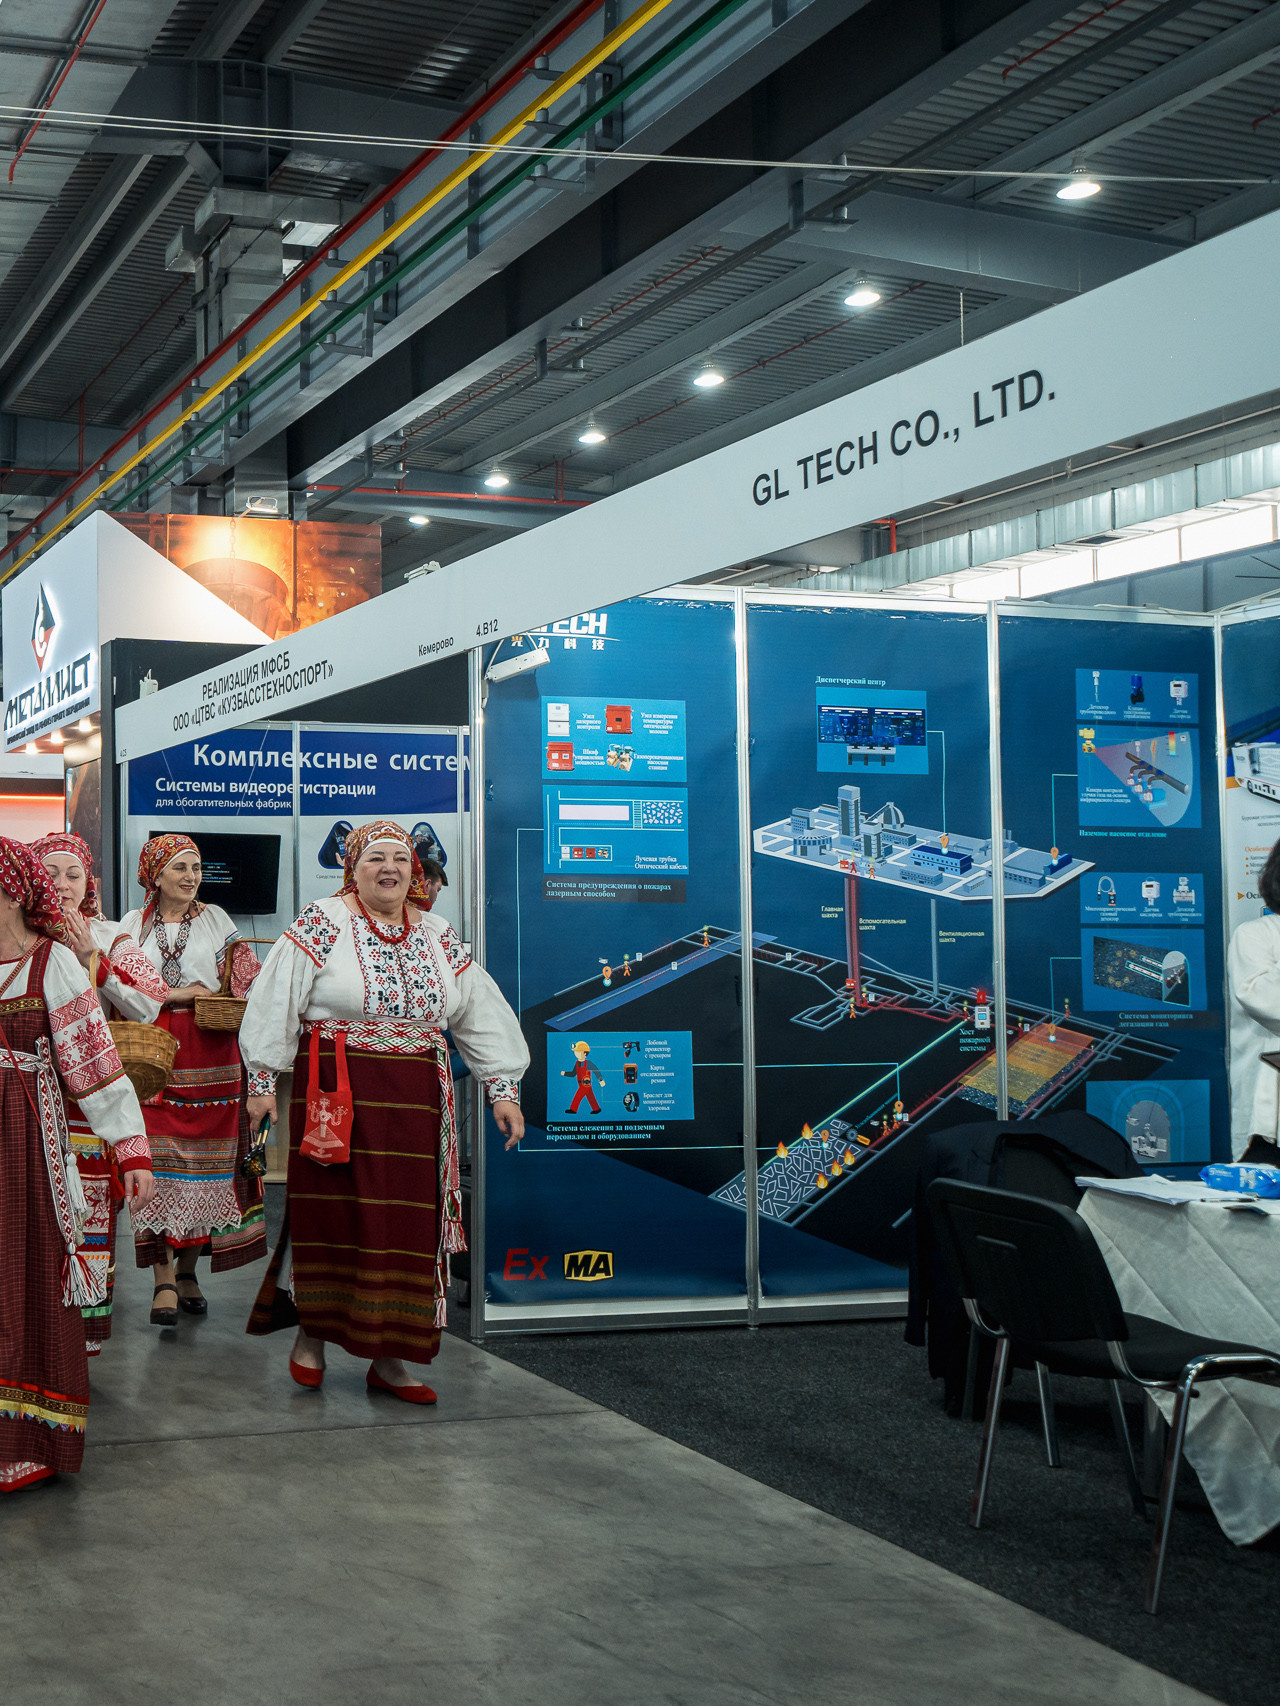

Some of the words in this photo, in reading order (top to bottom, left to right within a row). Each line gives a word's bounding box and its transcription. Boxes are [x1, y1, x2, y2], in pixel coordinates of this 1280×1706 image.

[752, 473, 789, 505] GL
[797, 431, 878, 489] TECH
[890, 410, 959, 456] CO.,
[973, 369, 1055, 428] LTD.
[418, 636, 454, 657] Кемерово
[202, 664, 259, 701] РЕАЛИЗАЦИЯ
[261, 651, 290, 678] МФСБ
[815, 676, 866, 686] Диспетчерский
[868, 679, 886, 687] центр
[4, 652, 91, 732] МЕТАЛЛИСТ
[173, 712, 190, 731] ООО
[191, 702, 216, 727] «ЦТВС
[218, 659, 334, 717] «КУЗБАССТЕХНОСПОРТ»
[194, 744, 378, 769] Комплексные
[155, 777, 225, 793] Системы
[229, 782, 376, 798] видеорегистрации
[155, 799, 173, 808] для
[176, 797, 253, 808] обогатительных
[255, 799, 292, 810] фабрик
[635, 855, 658, 863] Лучевая
[634, 862, 668, 870] Оптический
[546, 881, 577, 889] Система
[578, 882, 636, 891] предупреждения
[546, 890, 581, 898] лазерным
[939, 930, 985, 938] Вентиляционная
[1118, 1012, 1149, 1020] Система
[960, 1036, 991, 1044] пожарной
[546, 1124, 578, 1132] Система
[597, 1132, 651, 1141] оборудованием
[503, 1248, 550, 1281] Ex
[566, 1254, 612, 1278] MA
